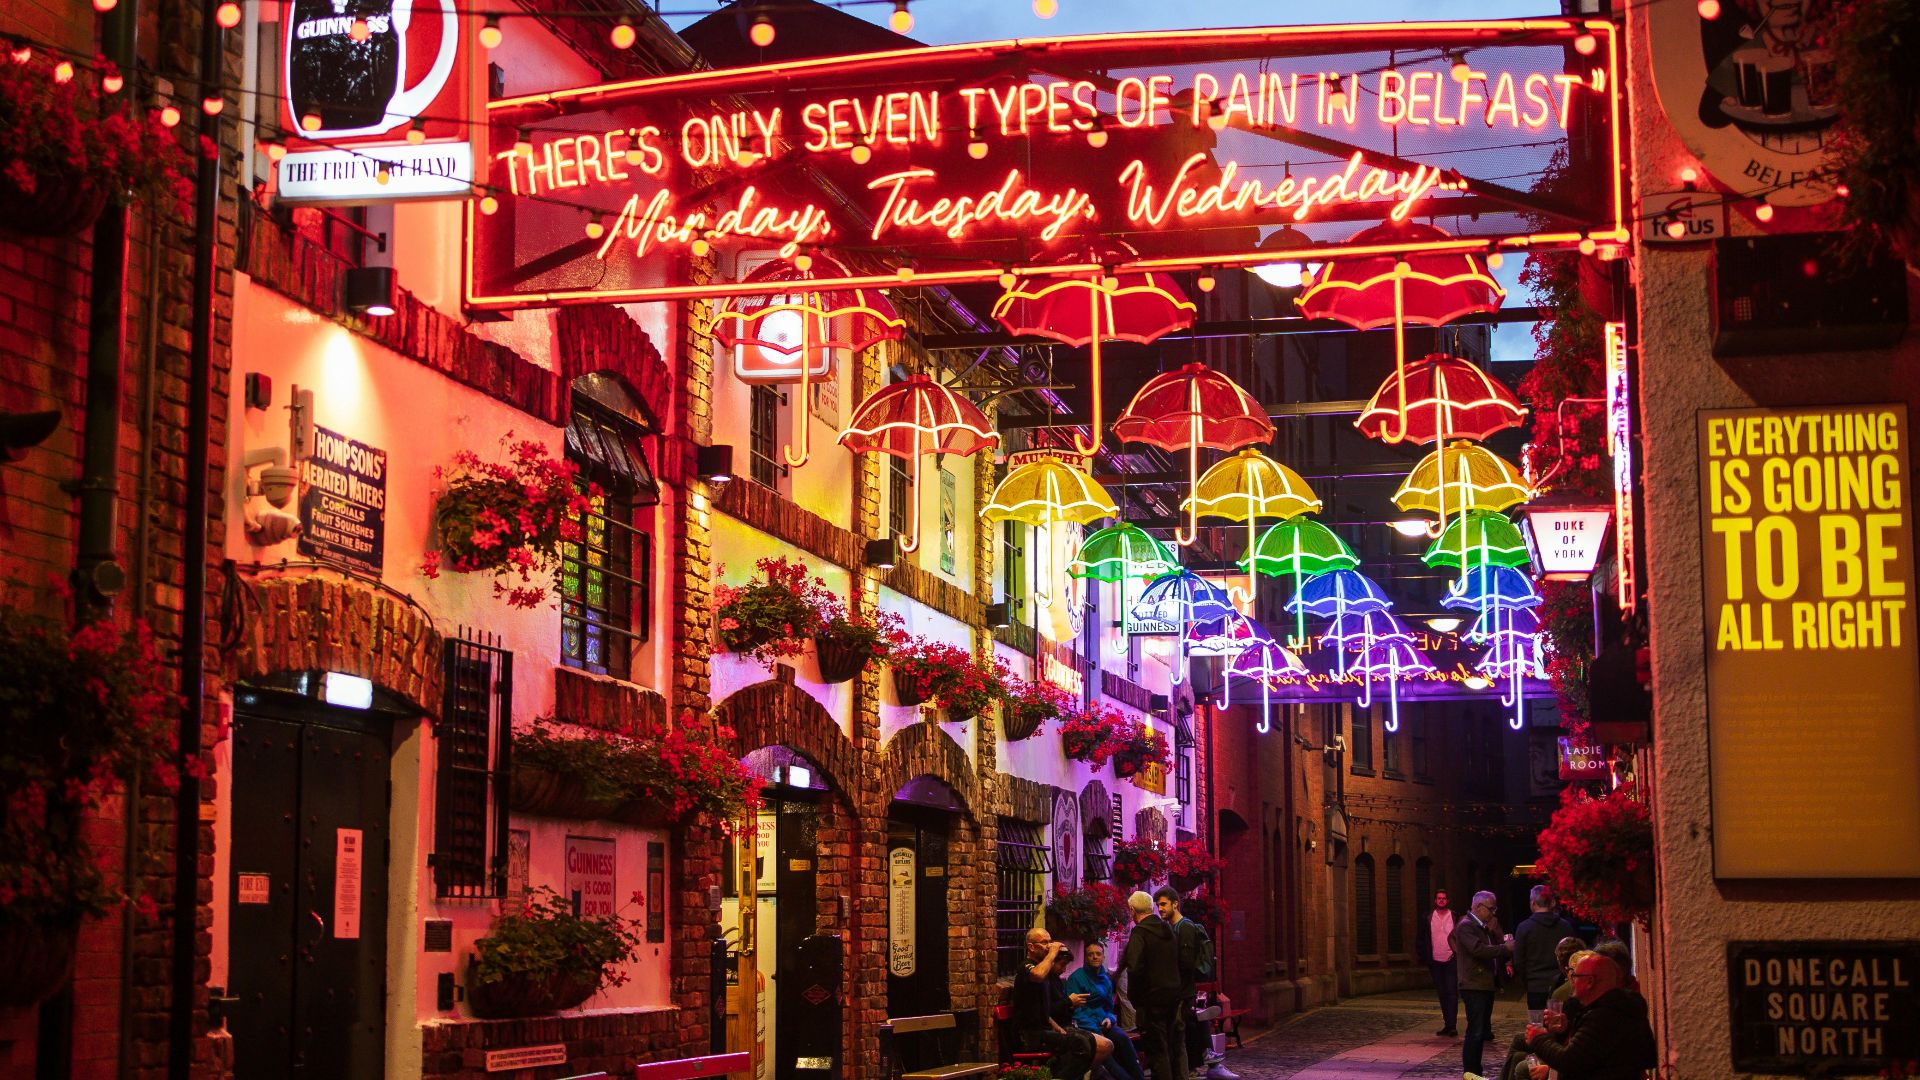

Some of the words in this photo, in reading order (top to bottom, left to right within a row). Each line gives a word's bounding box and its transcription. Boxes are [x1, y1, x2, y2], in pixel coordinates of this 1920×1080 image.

[297, 16, 390, 39] GUINNSS
[496, 125, 663, 196] THERE'S
[681, 107, 783, 168] ONLY
[802, 91, 939, 152] SEVEN
[960, 80, 1097, 137] TYPES
[1116, 75, 1173, 128] OF
[1317, 72, 1358, 125] IN
[286, 162, 318, 183] THE
[596, 185, 830, 259] Monday,
[867, 169, 1097, 242] Tuesday,
[1652, 218, 1715, 236] fous
[1707, 412, 1899, 456] EVERYTHING
[302, 460, 348, 497] AERATED
[348, 474, 384, 510] WATERS
[1710, 458, 1752, 515] IS
[1762, 454, 1902, 512] GOING
[312, 507, 333, 530] FRUIT
[334, 514, 375, 540] SQUASHES
[321, 495, 366, 522] CORDIALS
[311, 524, 340, 544] ALWAYS
[341, 532, 354, 547] THE
[354, 537, 373, 554] BEST
[1554, 521, 1585, 531] DUKE
[1562, 535, 1576, 545] OF
[1554, 549, 1585, 558] YORK
[1711, 516, 1800, 600] TO
[1820, 514, 1906, 598] BE
[1127, 622, 1177, 632] GUINNESS
[1716, 603, 1783, 651] ALL
[1792, 600, 1906, 650] RIGHT
[1570, 760, 1606, 770] ROOM
[567, 846, 613, 876] GUINNESS
[584, 881, 591, 895] IS
[592, 881, 612, 896] GOOD
[584, 901, 598, 915] FOR
[599, 901, 612, 915] YOU
[1767, 992, 1890, 1022] SQUARE
[1778, 1026, 1883, 1056] NORTH
